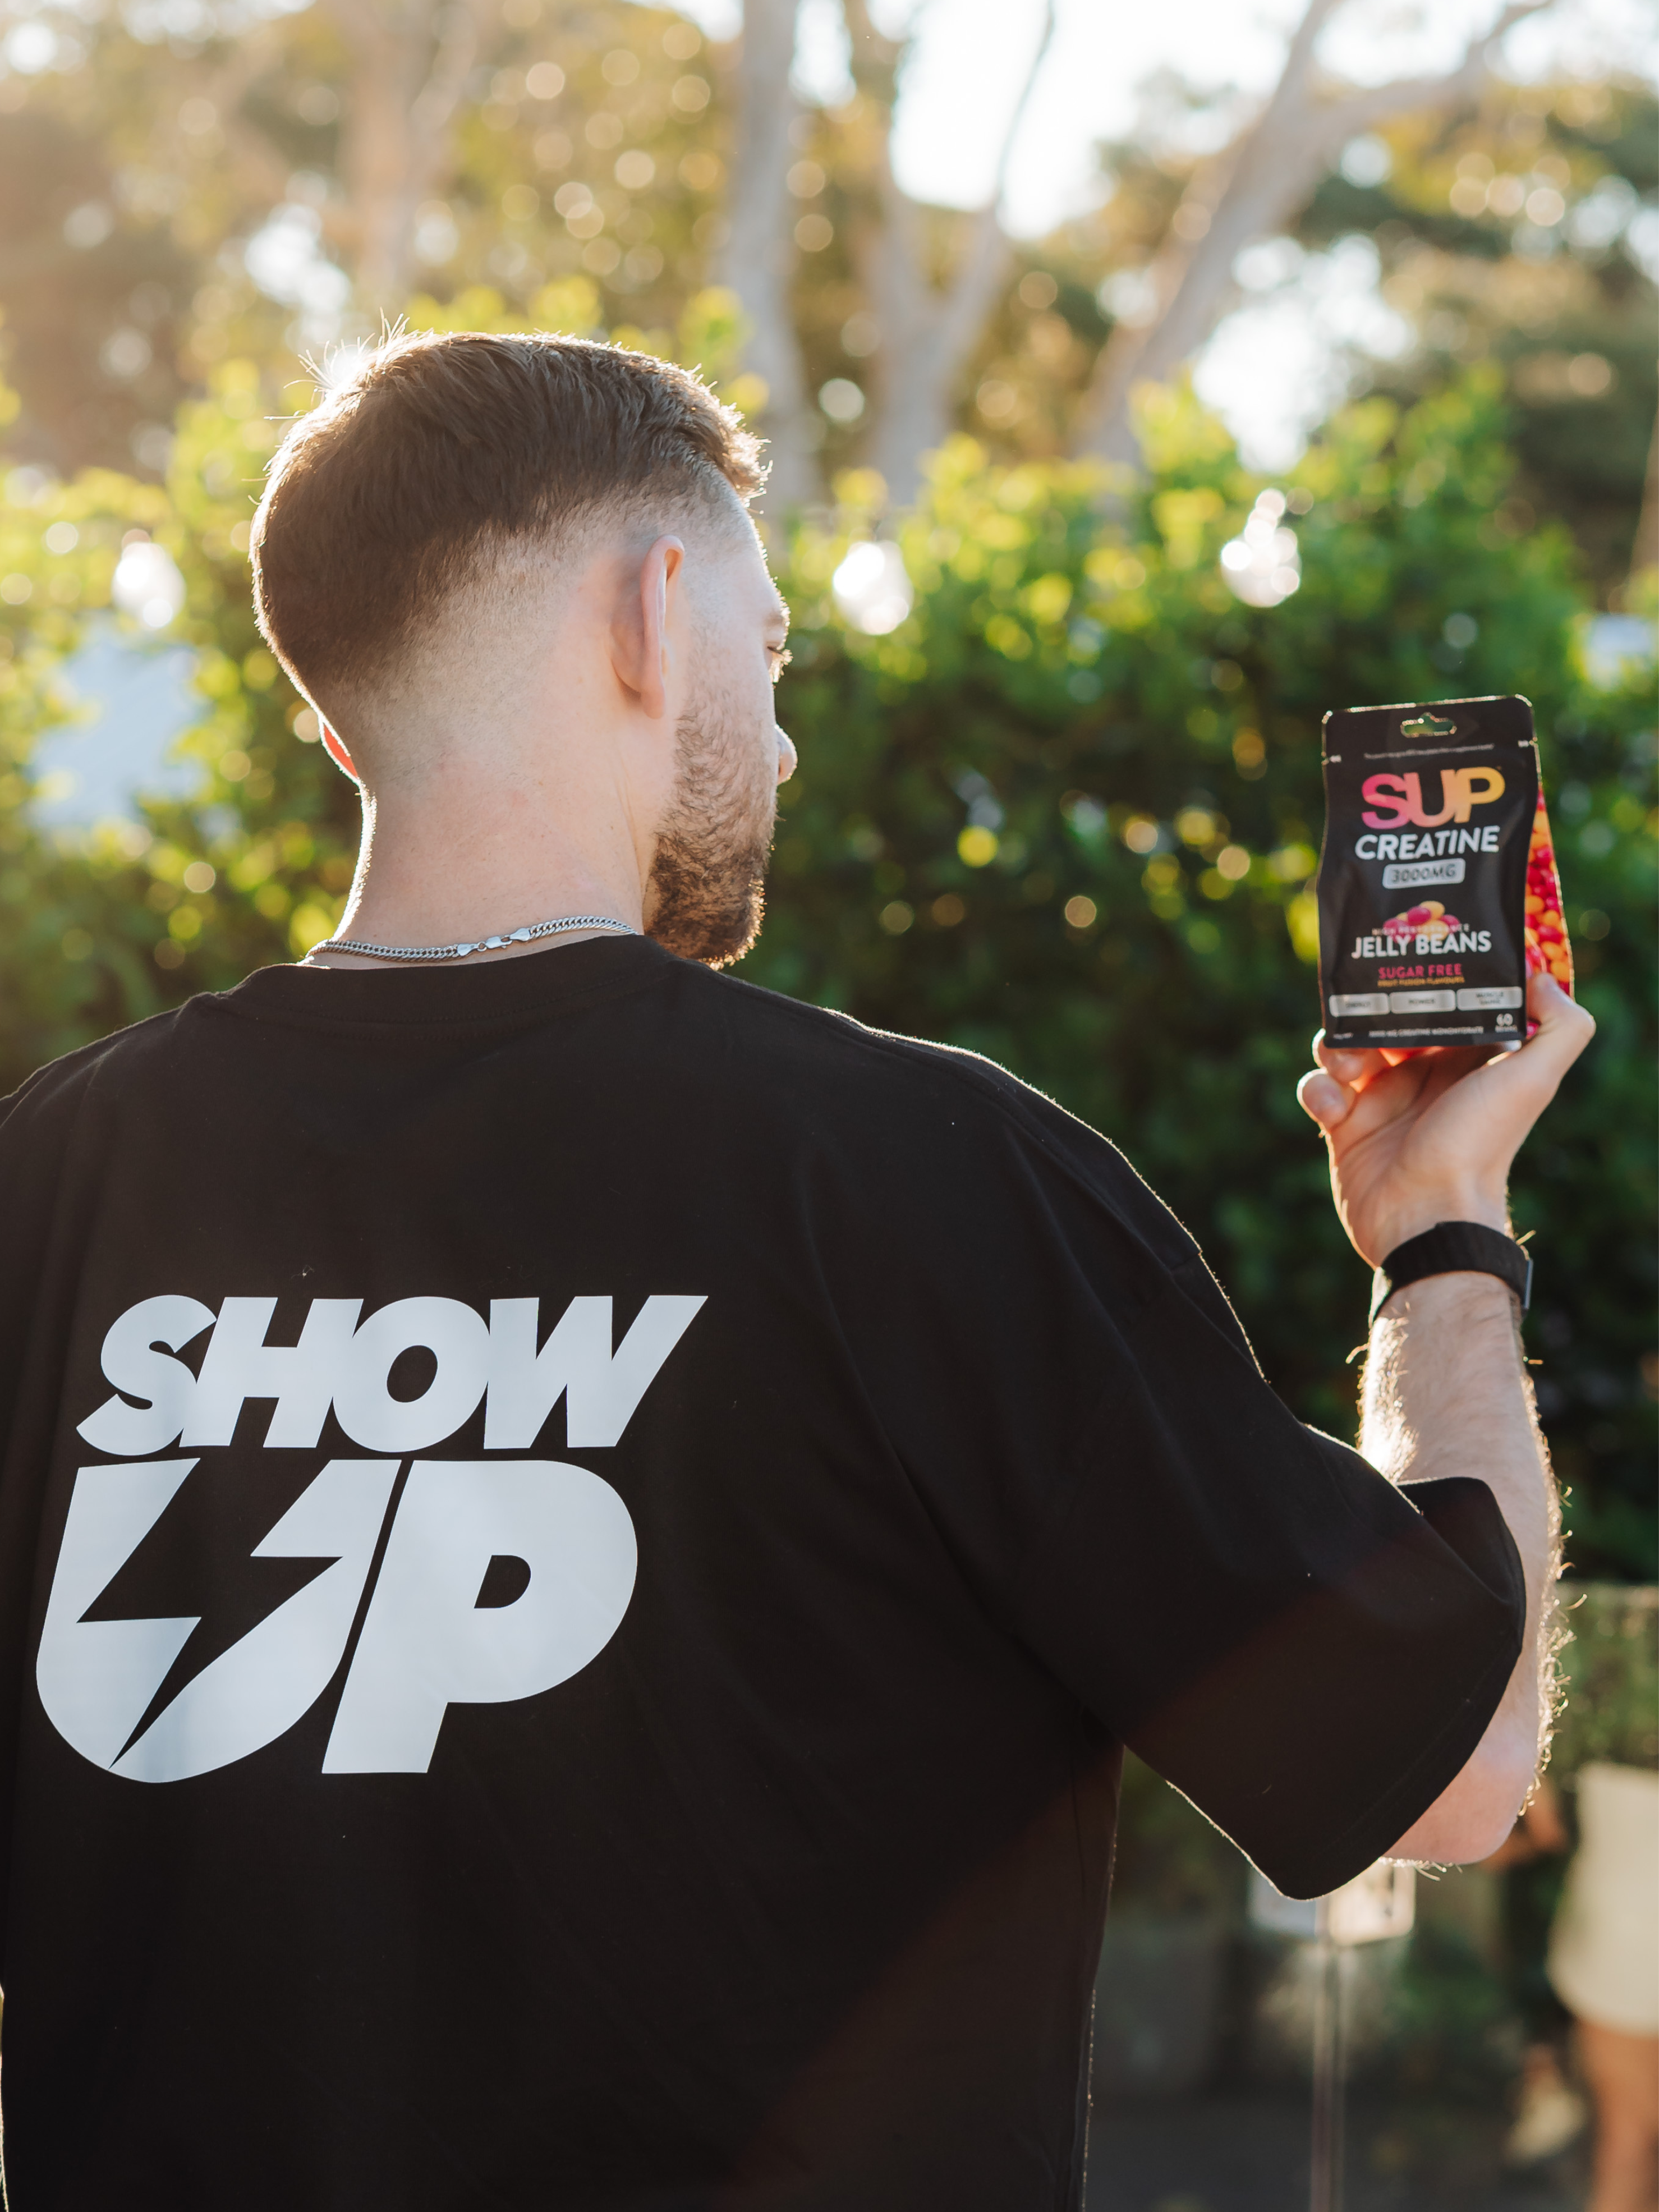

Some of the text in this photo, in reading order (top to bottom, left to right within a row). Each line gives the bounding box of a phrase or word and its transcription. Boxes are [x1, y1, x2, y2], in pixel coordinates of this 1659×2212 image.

[1362, 767, 1505, 829] SUP
[1355, 825, 1500, 860] CREATINE
[1391, 864, 1456, 883] 3000MG
[1351, 930, 1492, 959] JELLY BEANS
[1378, 963, 1462, 979] SUGAR FREE
[1496, 1013, 1513, 1026] 60
[76, 1295, 708, 1456] SHOW
[36, 1458, 638, 1783] UP
